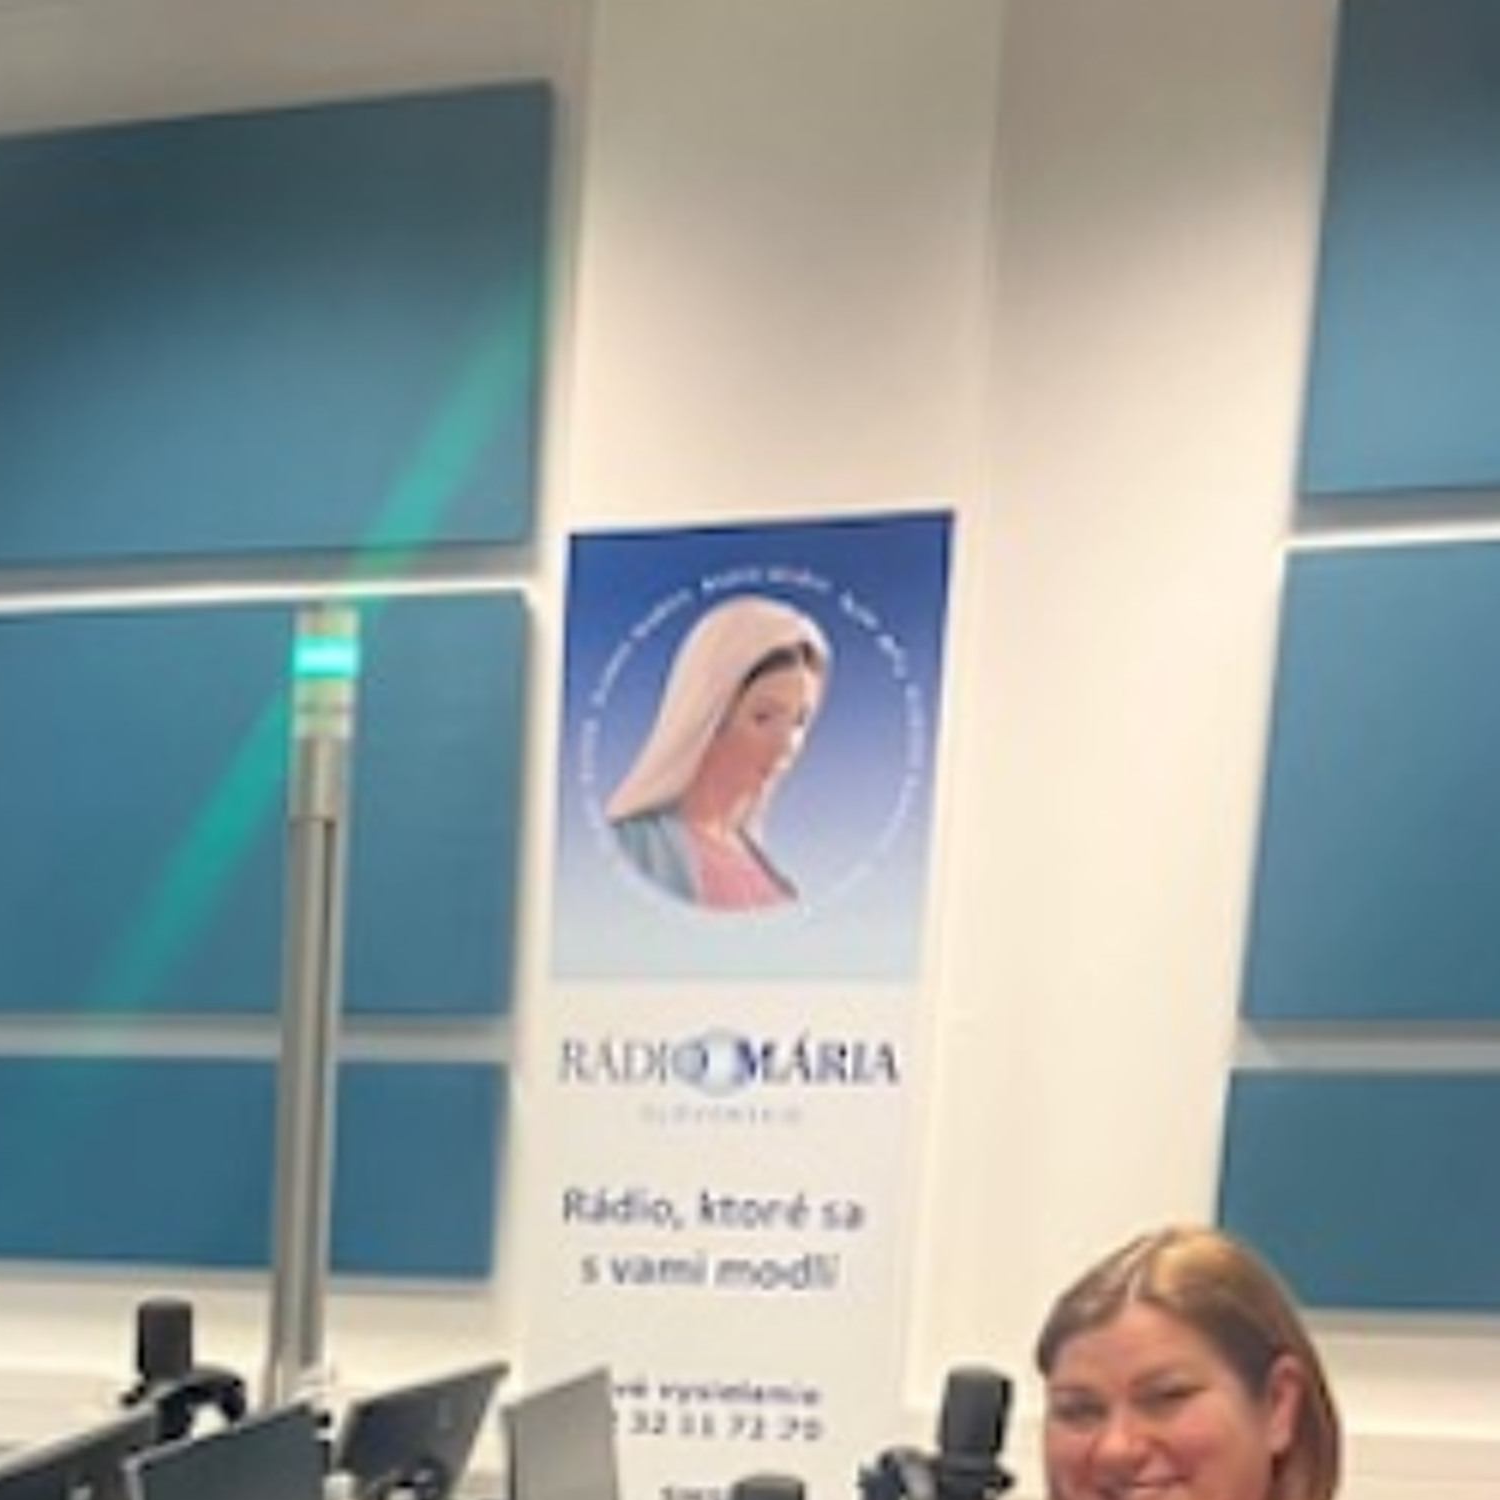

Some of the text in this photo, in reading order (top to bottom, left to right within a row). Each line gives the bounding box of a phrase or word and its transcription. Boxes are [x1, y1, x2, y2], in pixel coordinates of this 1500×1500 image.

[733, 1031, 899, 1084] MÁRIA
[562, 1187, 866, 1231] Rádio, ktoré sa
[581, 1255, 599, 1285] s
[609, 1251, 708, 1286] vami
